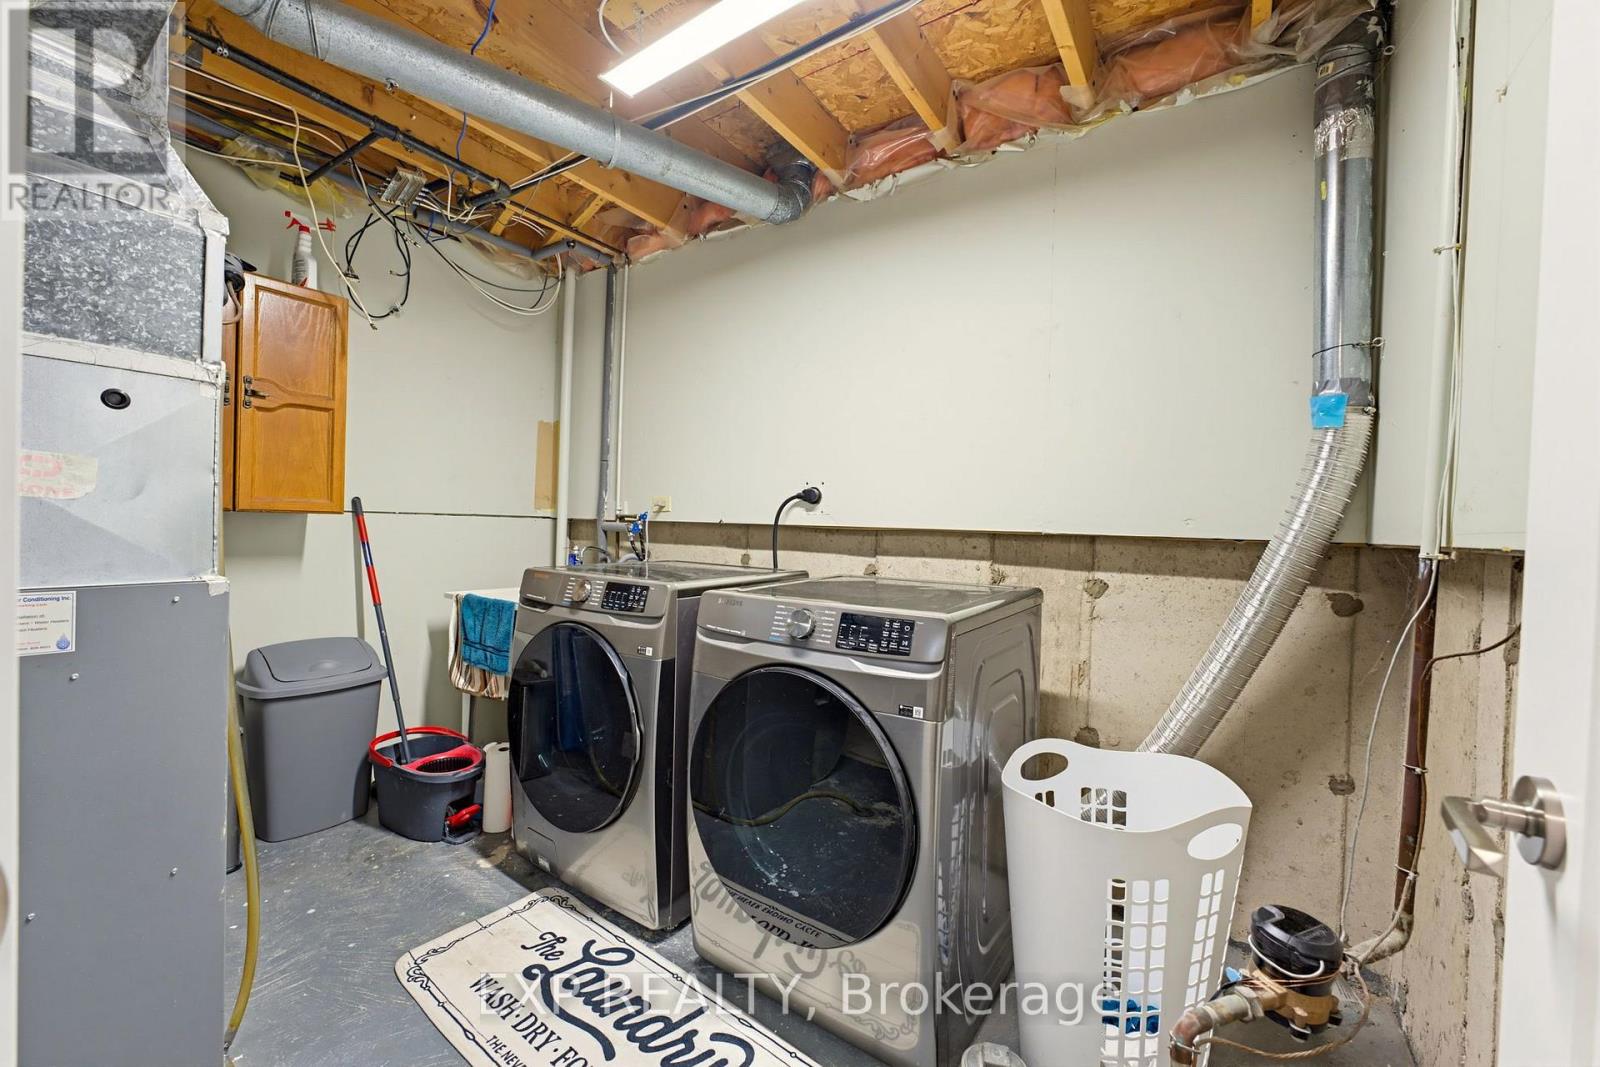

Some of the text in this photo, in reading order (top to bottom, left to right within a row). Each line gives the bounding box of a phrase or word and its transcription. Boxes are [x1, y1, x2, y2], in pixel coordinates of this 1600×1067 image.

[520, 931, 567, 961] The
[511, 1012, 562, 1052] DRY
[486, 1035, 528, 1067] THE NEV
